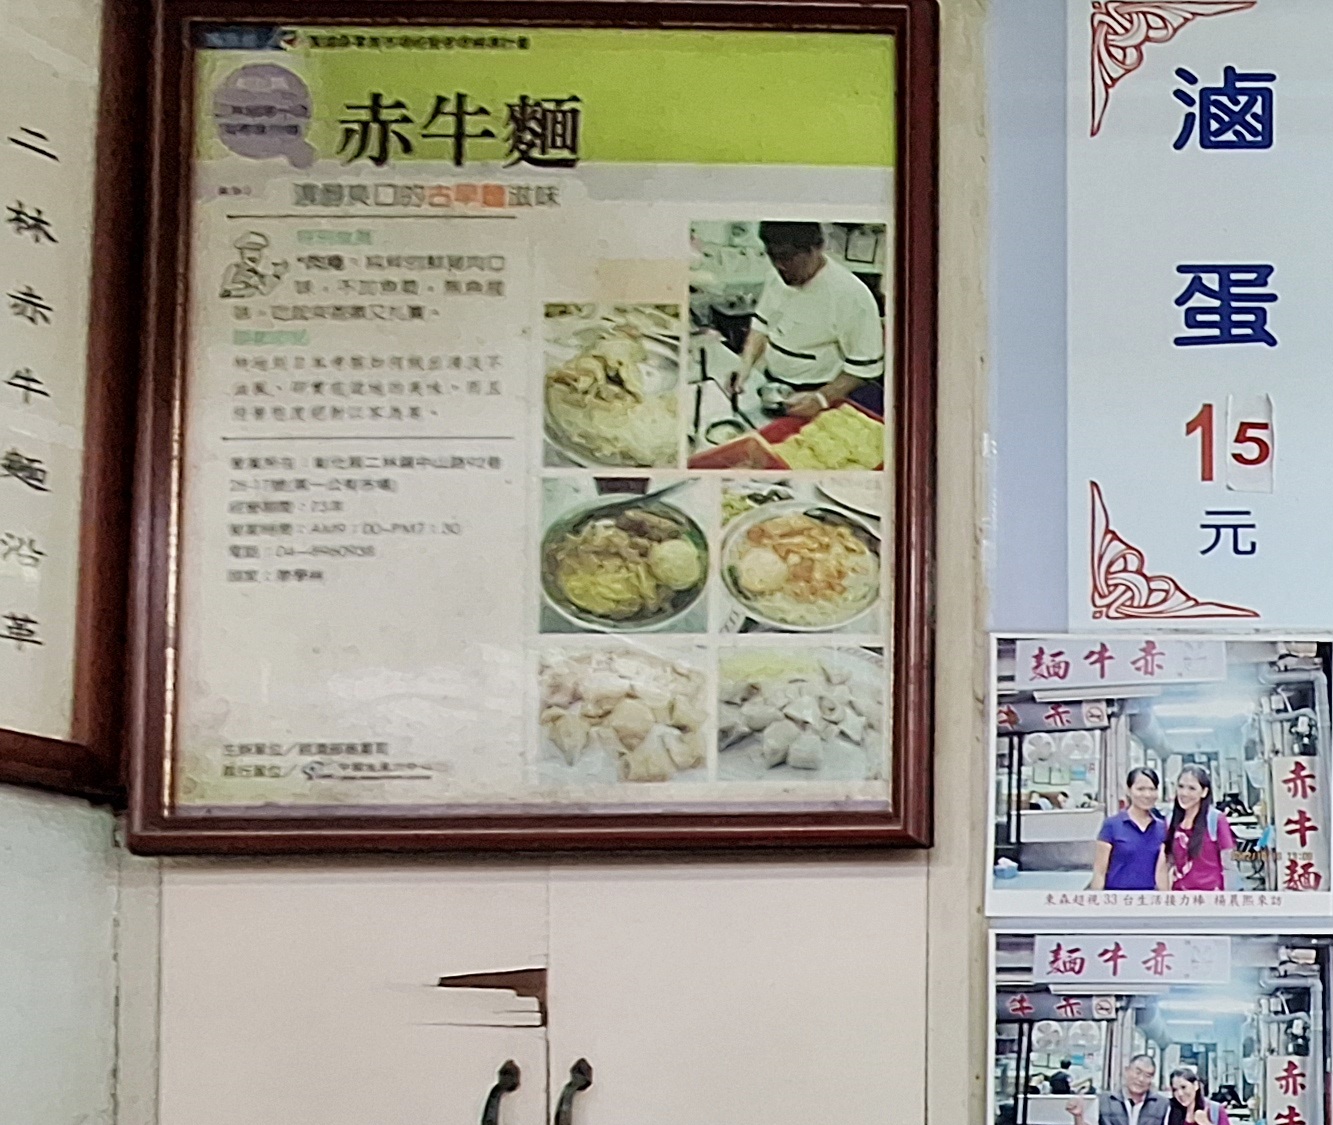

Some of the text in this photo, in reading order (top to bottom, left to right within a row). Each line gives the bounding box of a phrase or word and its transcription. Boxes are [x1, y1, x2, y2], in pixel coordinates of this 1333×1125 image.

[336, 92, 583, 168] 赤牛麵
[1171, 66, 1279, 348] 滷蛋
[1185, 403, 1272, 482] 15
[1199, 510, 1257, 556] 元
